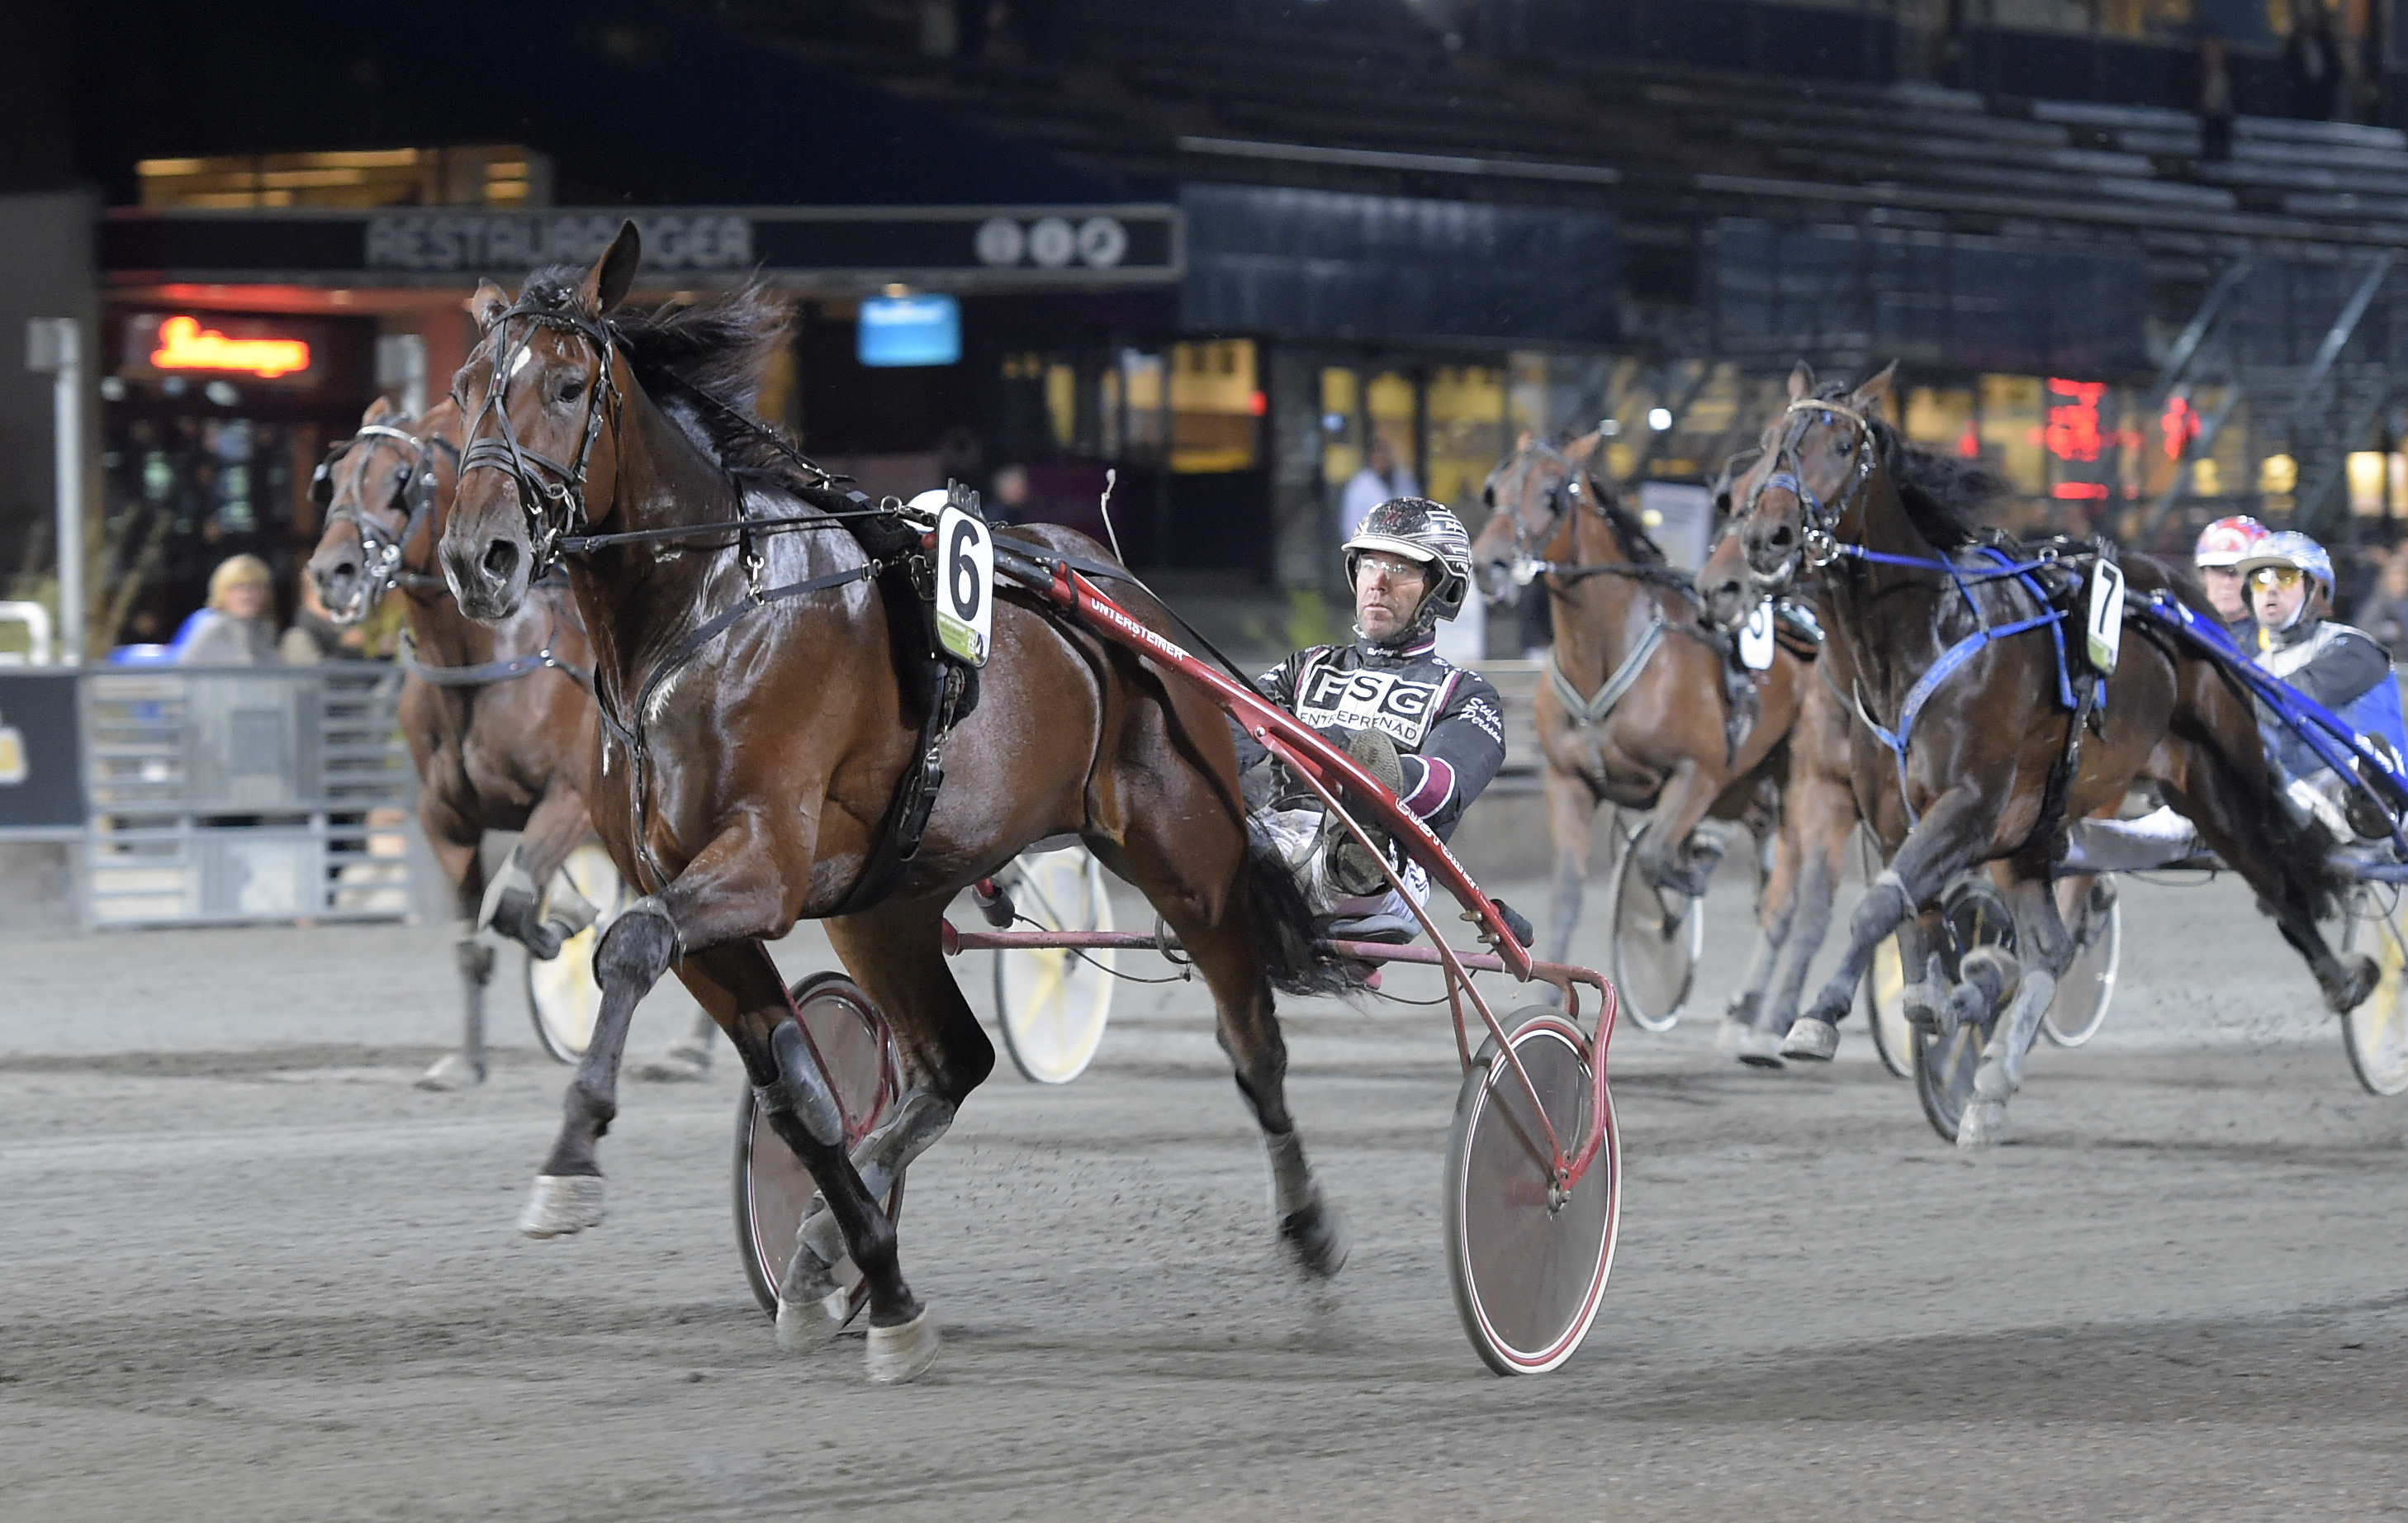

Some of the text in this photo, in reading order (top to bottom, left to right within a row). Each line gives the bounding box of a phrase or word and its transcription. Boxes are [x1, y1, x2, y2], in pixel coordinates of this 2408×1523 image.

[949, 519, 980, 622] 6
[2098, 564, 2118, 634] 7
[1091, 597, 1185, 662] UNTERSTEINER
[1311, 671, 1430, 716] FSG
[1465, 697, 1502, 731] Stefan
[1457, 707, 1502, 744] Persson
